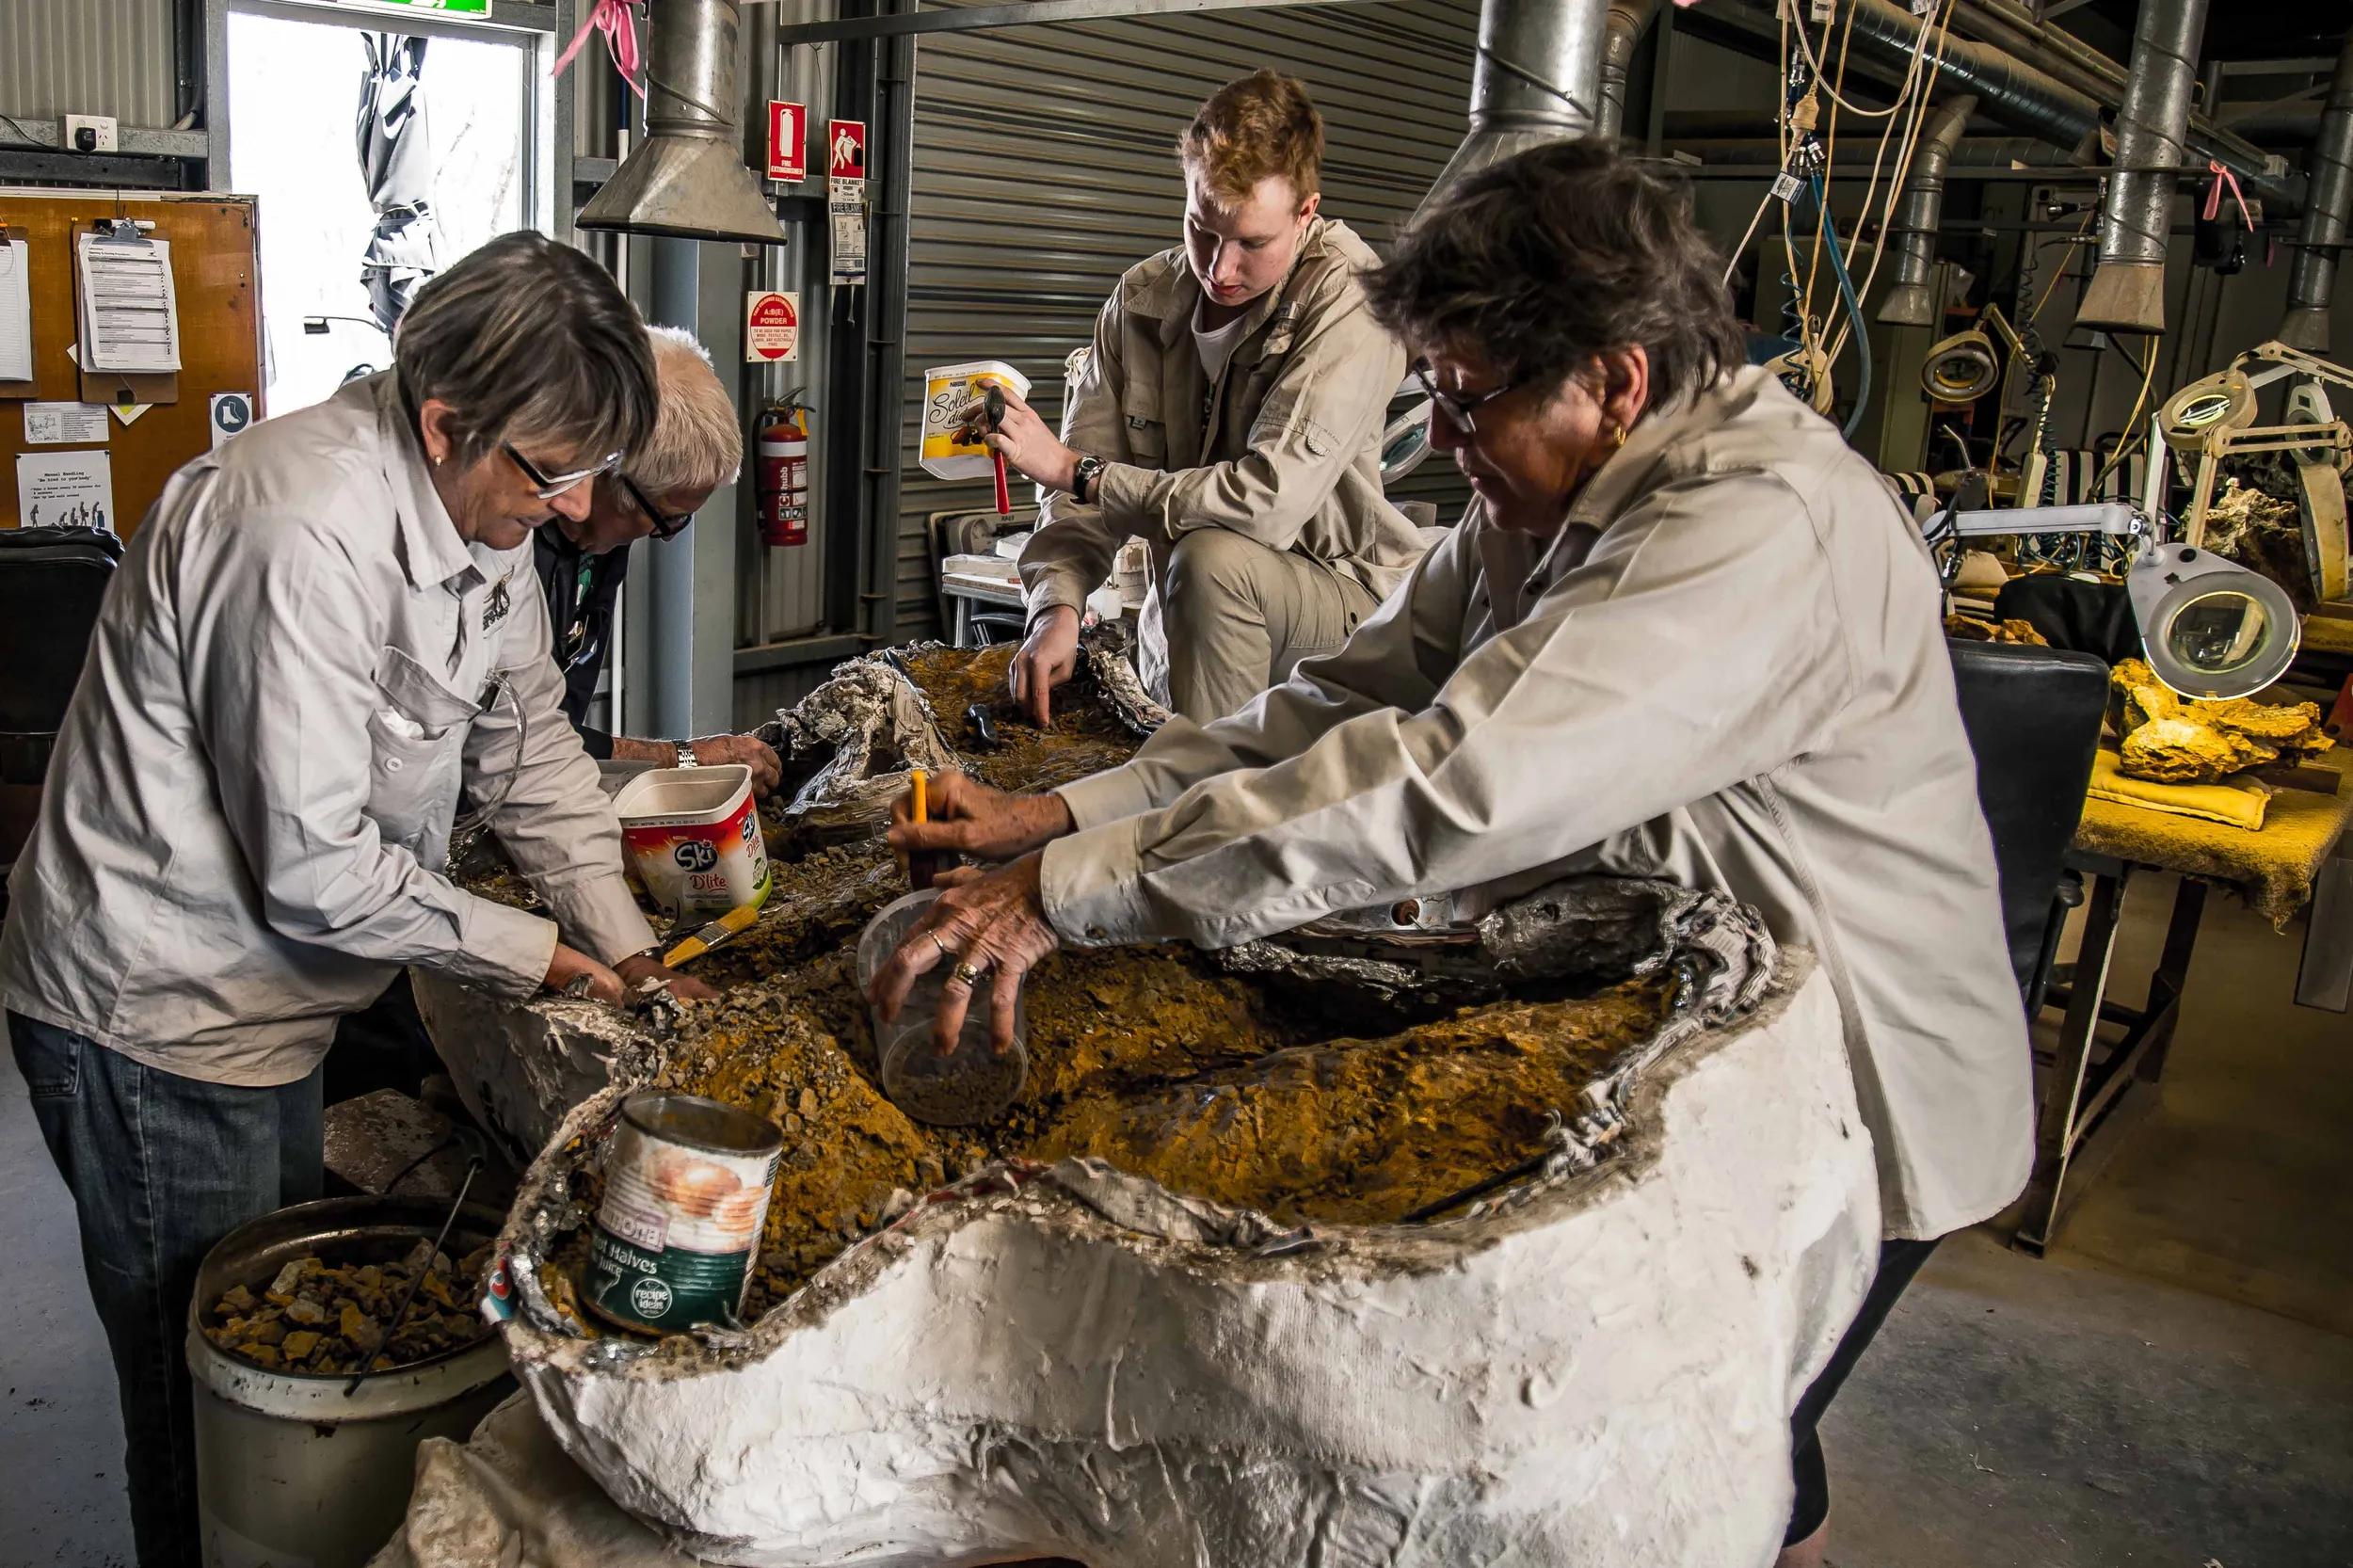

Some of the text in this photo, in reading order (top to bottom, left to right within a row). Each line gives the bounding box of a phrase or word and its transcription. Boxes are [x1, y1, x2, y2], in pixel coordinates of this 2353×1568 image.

[929, 383, 977, 424] Soleil
[677, 844, 715, 872] Ski
[689, 873, 727, 890] D'lite
[609, 1242, 657, 1274] Halves
[635, 1289, 668, 1302] recipe
[638, 1298, 664, 1310] ideas
